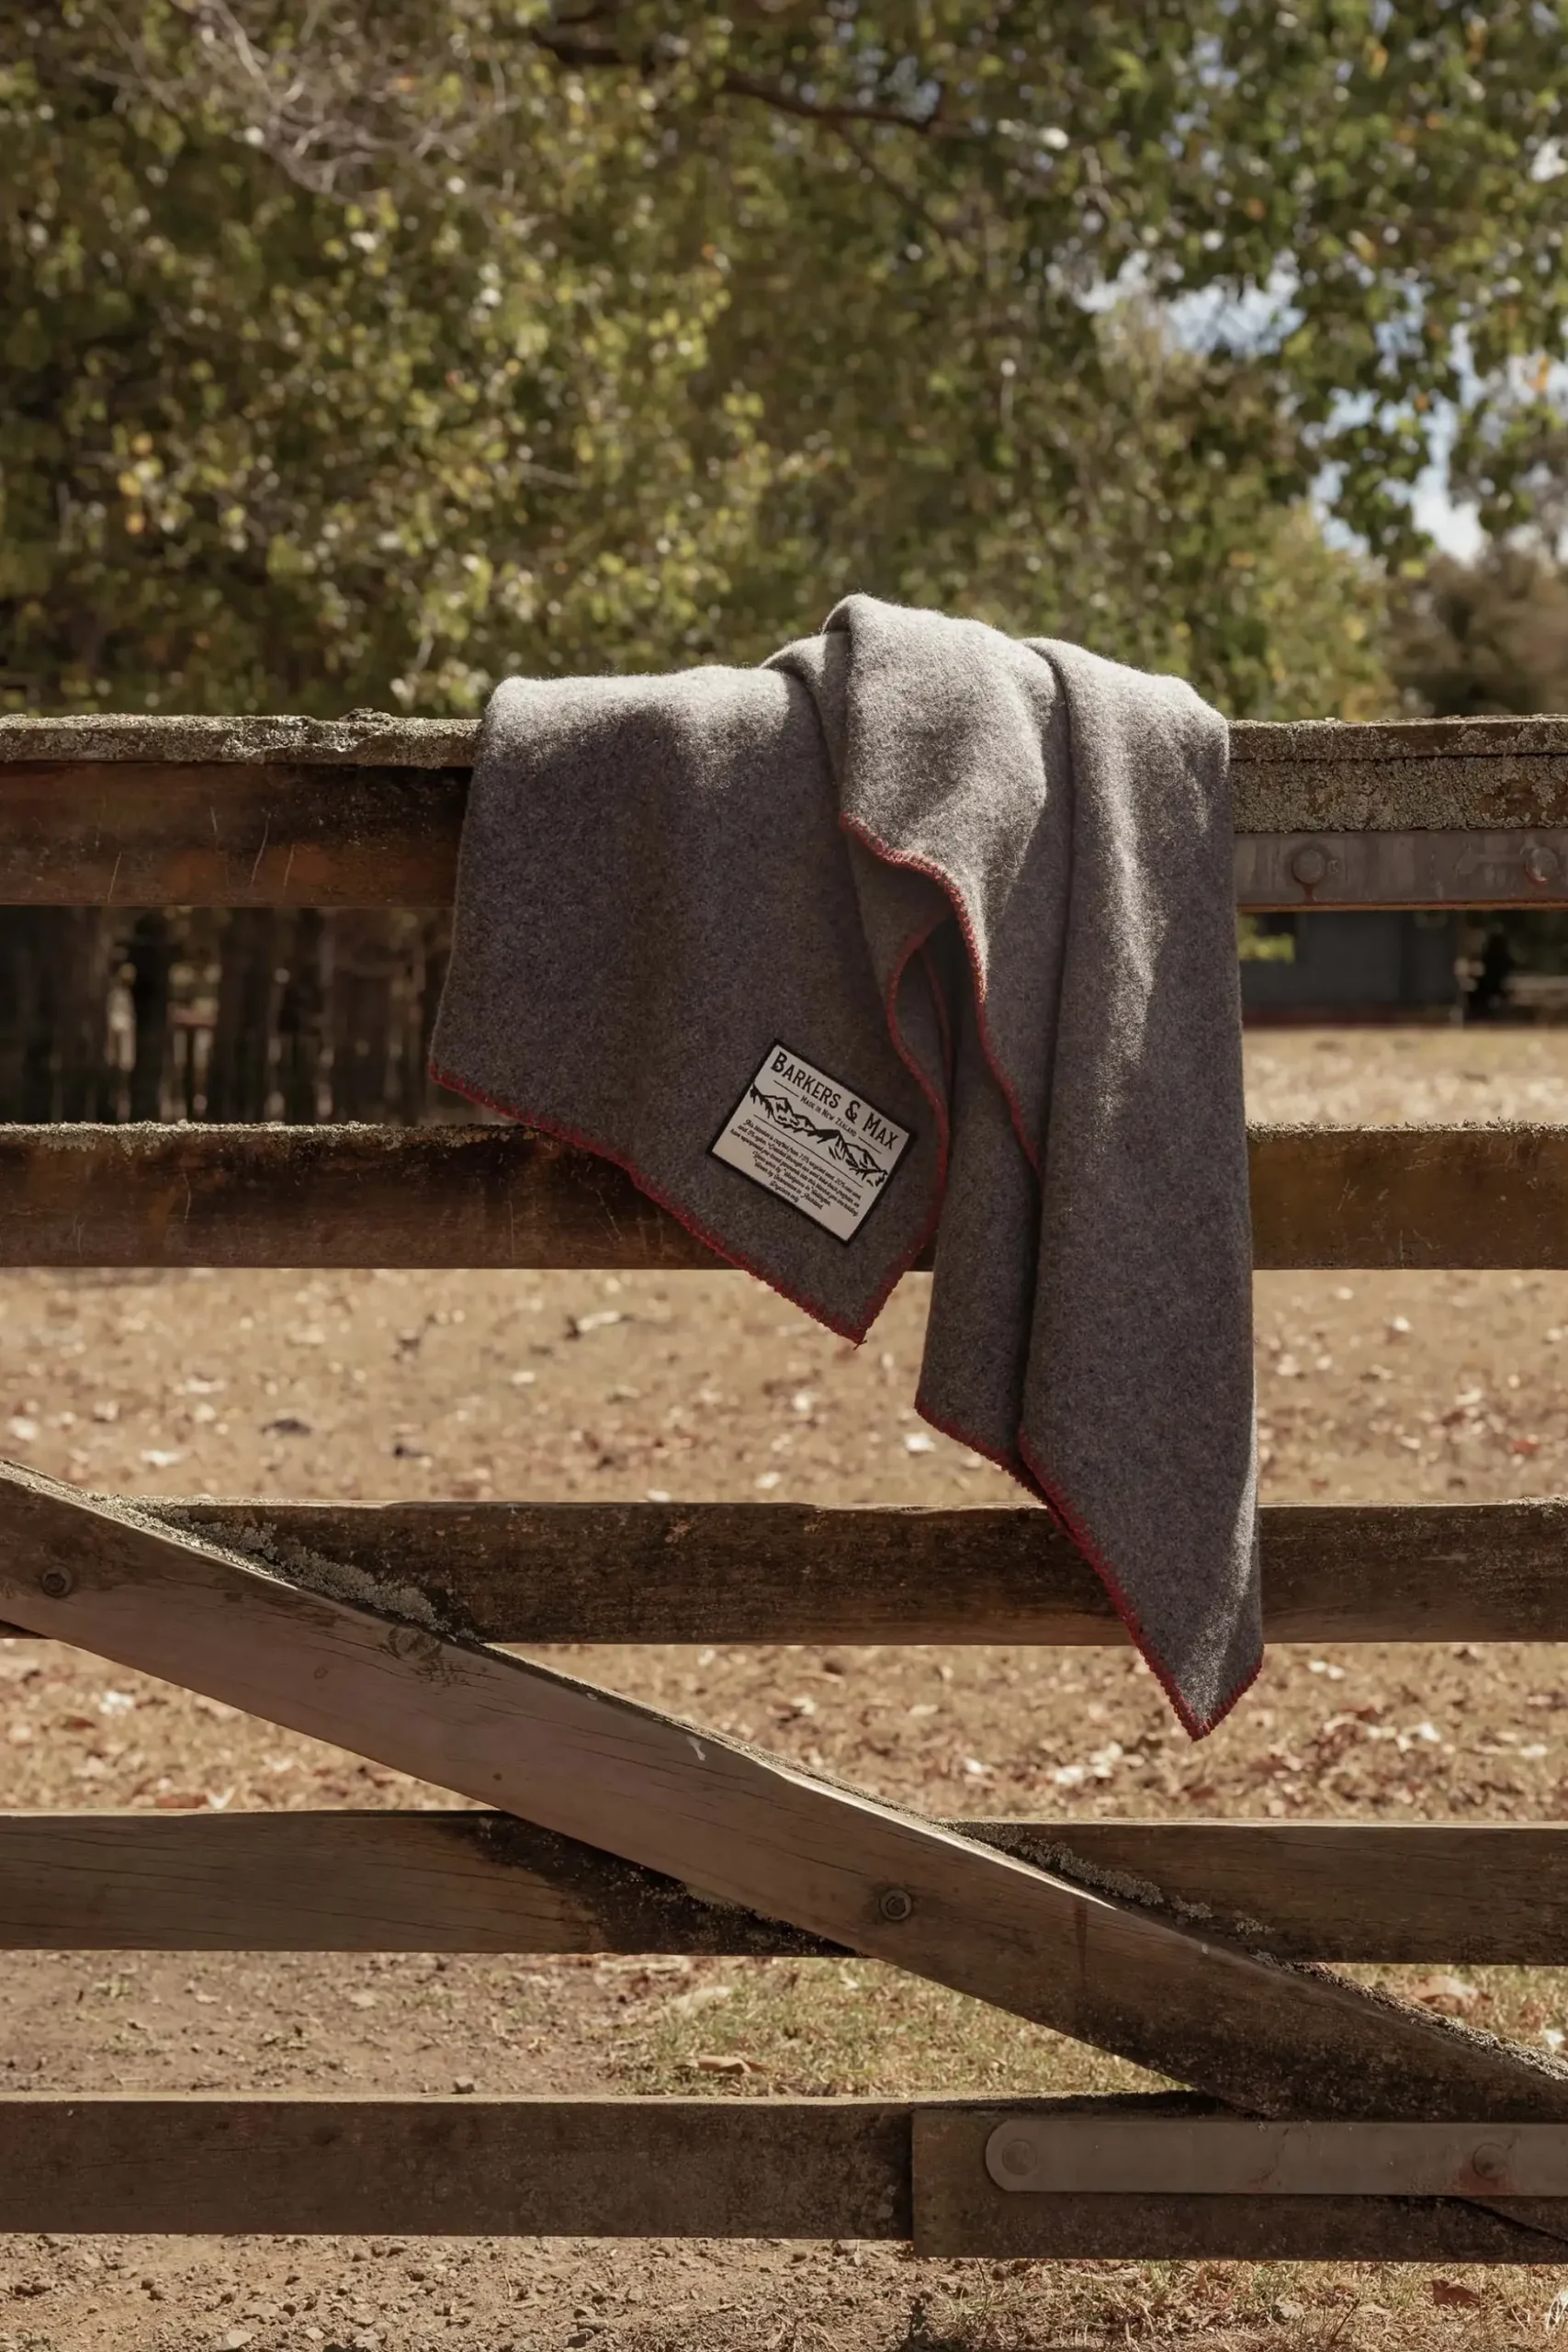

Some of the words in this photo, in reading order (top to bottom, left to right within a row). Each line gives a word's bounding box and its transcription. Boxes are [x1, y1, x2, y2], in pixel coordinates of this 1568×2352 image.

[770, 1051, 841, 1109] BARKERS
[844, 1100, 861, 1125] &
[862, 1112, 899, 1150] MAX
